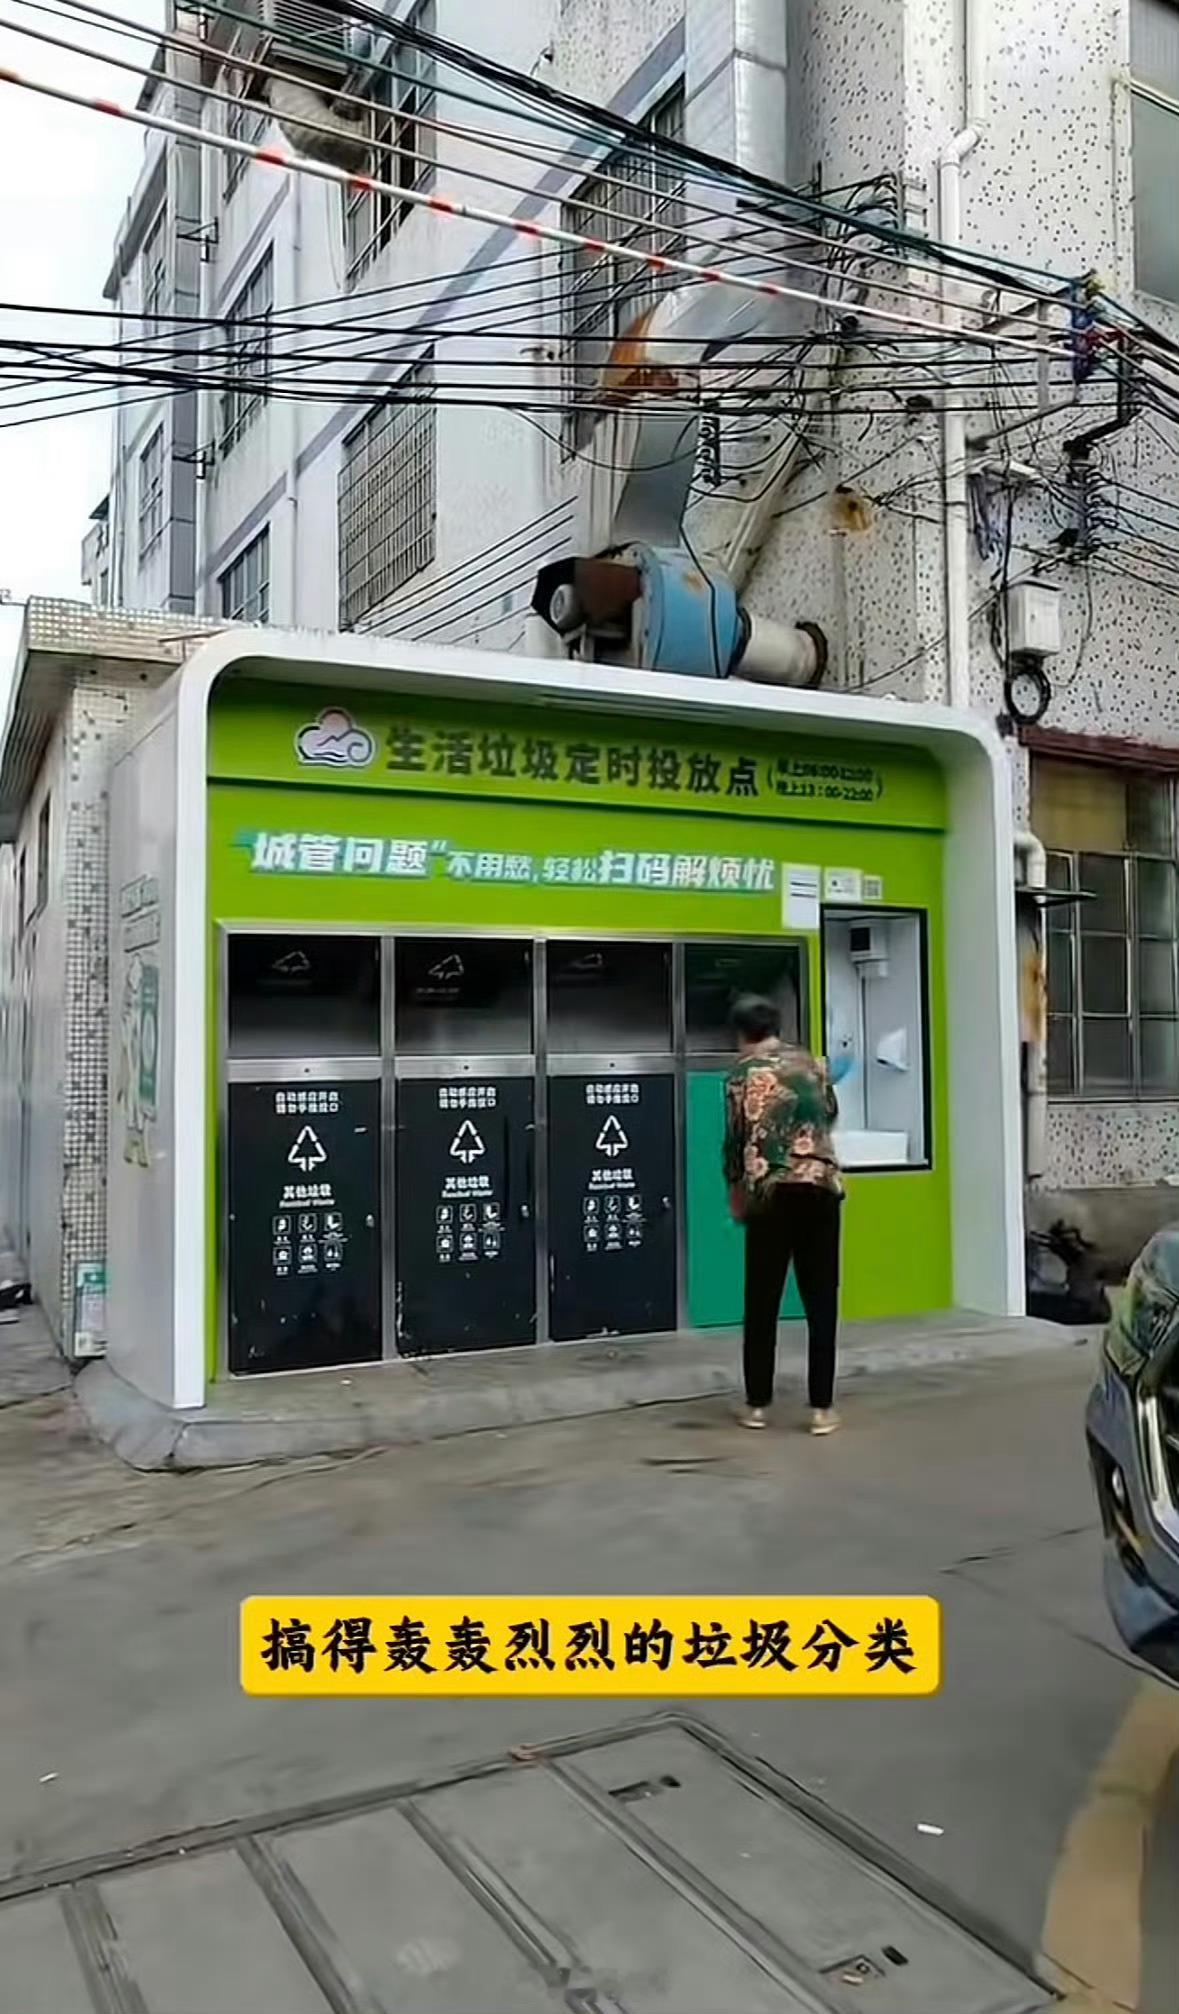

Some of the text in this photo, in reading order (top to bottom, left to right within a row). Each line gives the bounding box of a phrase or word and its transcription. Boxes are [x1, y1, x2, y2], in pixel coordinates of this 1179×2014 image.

[386, 726, 759, 797] 生活垃圾定时投放点
